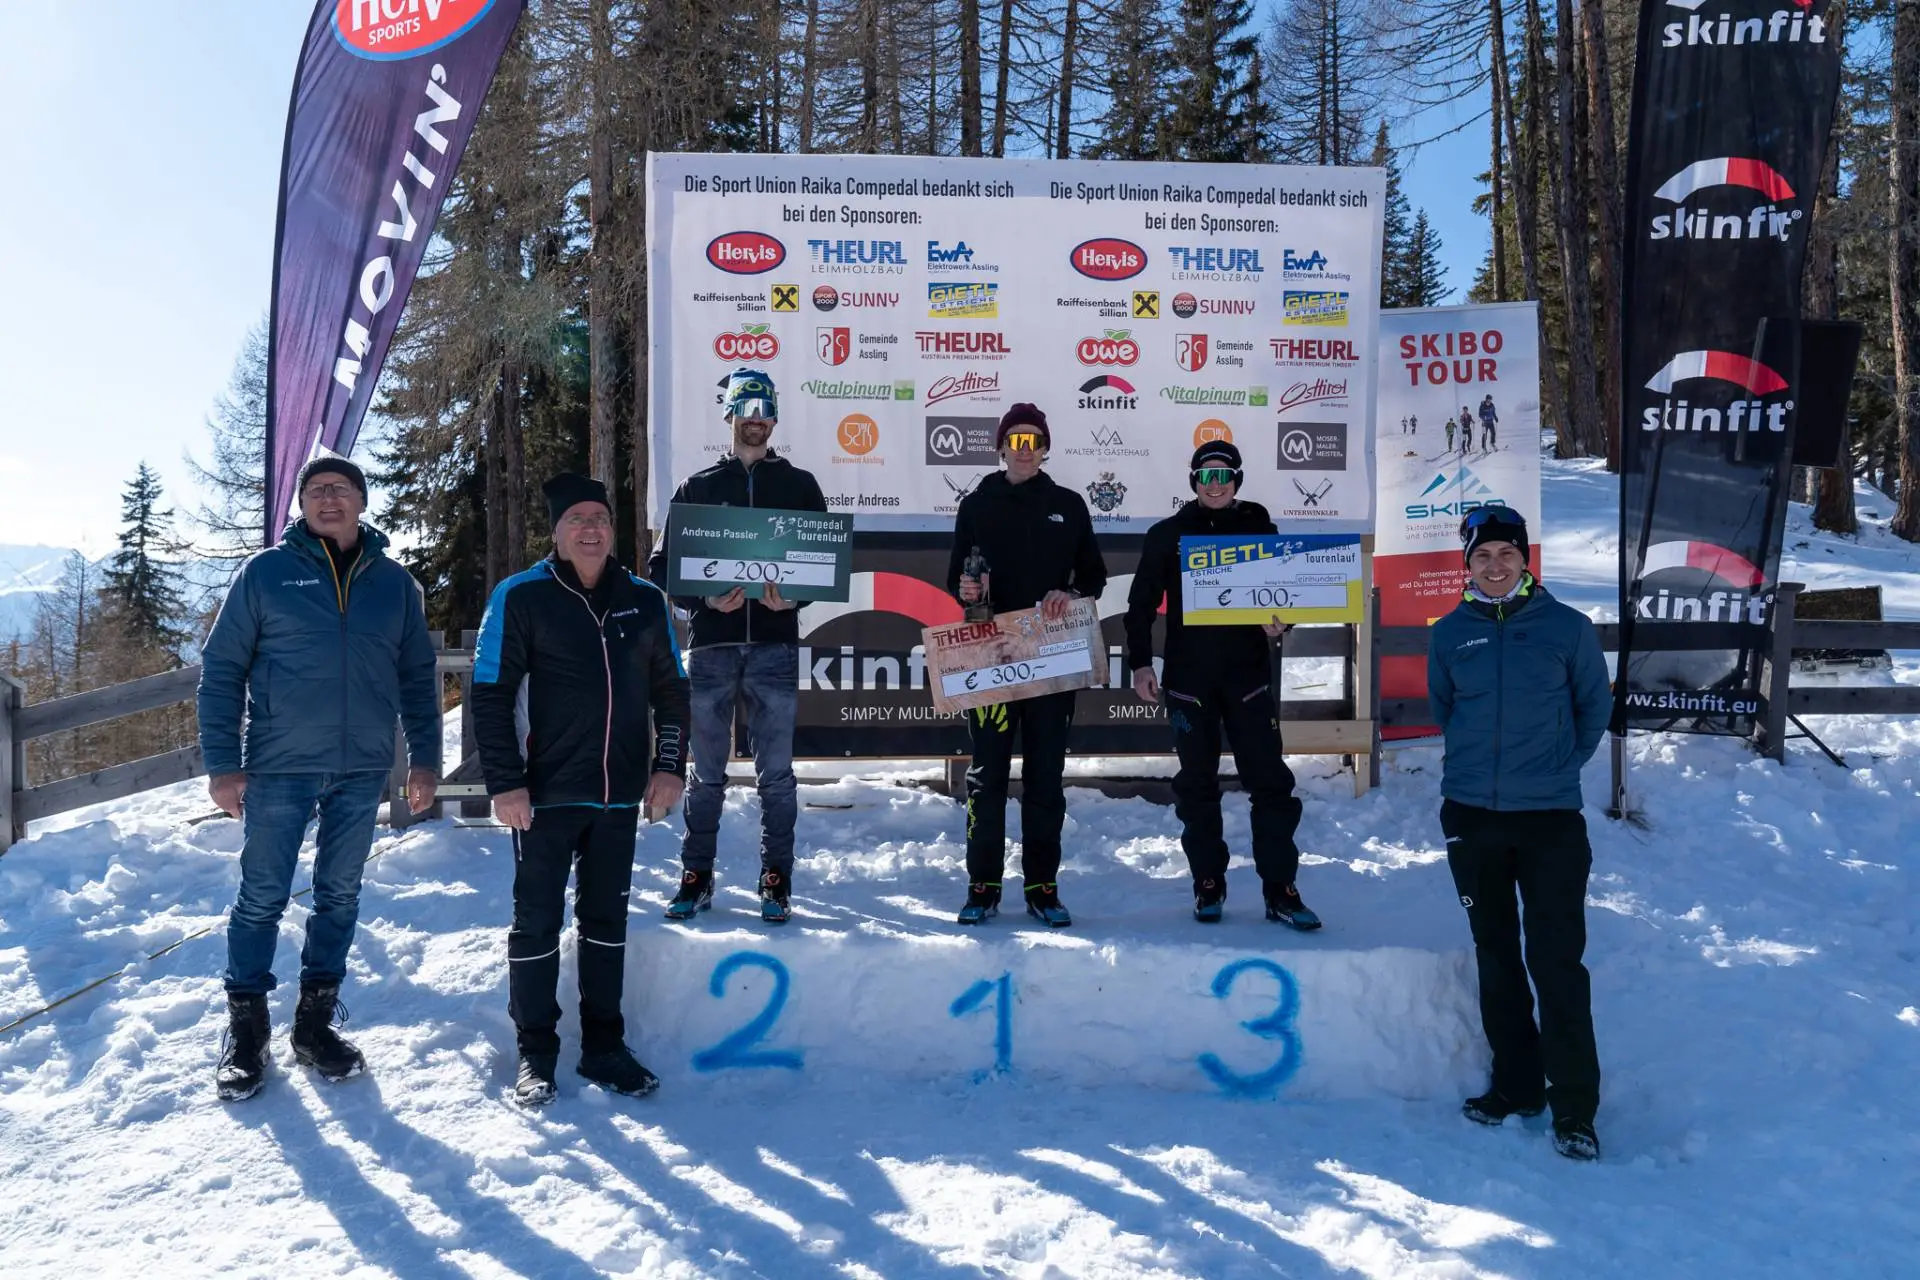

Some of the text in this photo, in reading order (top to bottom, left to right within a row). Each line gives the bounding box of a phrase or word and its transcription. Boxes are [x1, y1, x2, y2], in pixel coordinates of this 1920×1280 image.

[368, 17, 420, 46] SPORTS
[1662, 10, 1826, 47] skinfit
[684, 175, 1014, 200] Die Sport Union Raika Compedal bedankt sich
[1050, 182, 1368, 208] Die Sport Union Raika Compedal bedankt sich
[783, 205, 922, 227] bei den Sponsoren:
[1145, 212, 1279, 236] bei den Sponsoren:
[718, 243, 777, 264] Hervis
[808, 240, 908, 264] THEURL
[1082, 249, 1138, 270] Hervis
[1168, 247, 1264, 272] THEURL
[811, 264, 904, 275] LEIMHOLZBAU
[928, 263, 999, 273] Elektrowerk Assling
[1172, 271, 1260, 282] LEIMHOLZBAU
[1283, 271, 1350, 282] Elektrowerk Assling
[693, 293, 766, 302] Raiffeisenbank
[841, 292, 900, 308] SUNNY
[931, 284, 996, 303] GIETL
[737, 303, 766, 312] Sillian
[1057, 298, 1127, 308] Raiffeisenbank
[1200, 300, 1255, 315] SUNNY
[1099, 309, 1127, 317] Sillian
[719, 338, 774, 356] uwe
[859, 333, 898, 345] Gemeinde
[915, 332, 1011, 353] THEURL
[1216, 340, 1253, 351] Gemeinde
[1400, 330, 1503, 360] SKIBO
[859, 348, 888, 361] Assling
[1081, 342, 1134, 361] uwe
[1270, 338, 1360, 361] THEURL
[1216, 355, 1243, 367] Assling
[1406, 358, 1498, 386] TOUR
[801, 380, 891, 399] Vitalpinum
[1160, 385, 1247, 403] Vitalpinum
[824, 494, 900, 507] assler Andreas
[797, 517, 844, 531] Compedal
[682, 527, 759, 540] Andreas Passler
[797, 531, 848, 543] Tourenlauf
[1188, 543, 1273, 570] GIETL
[1305, 552, 1356, 564] Tourenlauf
[703, 560, 719, 579] €
[1190, 566, 1232, 578] ESTRICHE
[1194, 578, 1220, 586] Scheck
[1217, 588, 1232, 606] €
[1044, 616, 1094, 634] Tourenlauf
[932, 621, 1005, 648] THEURL
[965, 672, 979, 690] €
[841, 707, 894, 721] SIMPLY
[1108, 705, 1160, 719] SIMPLY
[692, 951, 803, 1072] 2
[950, 972, 1013, 1083] 1
[1199, 957, 1301, 1098] 3
